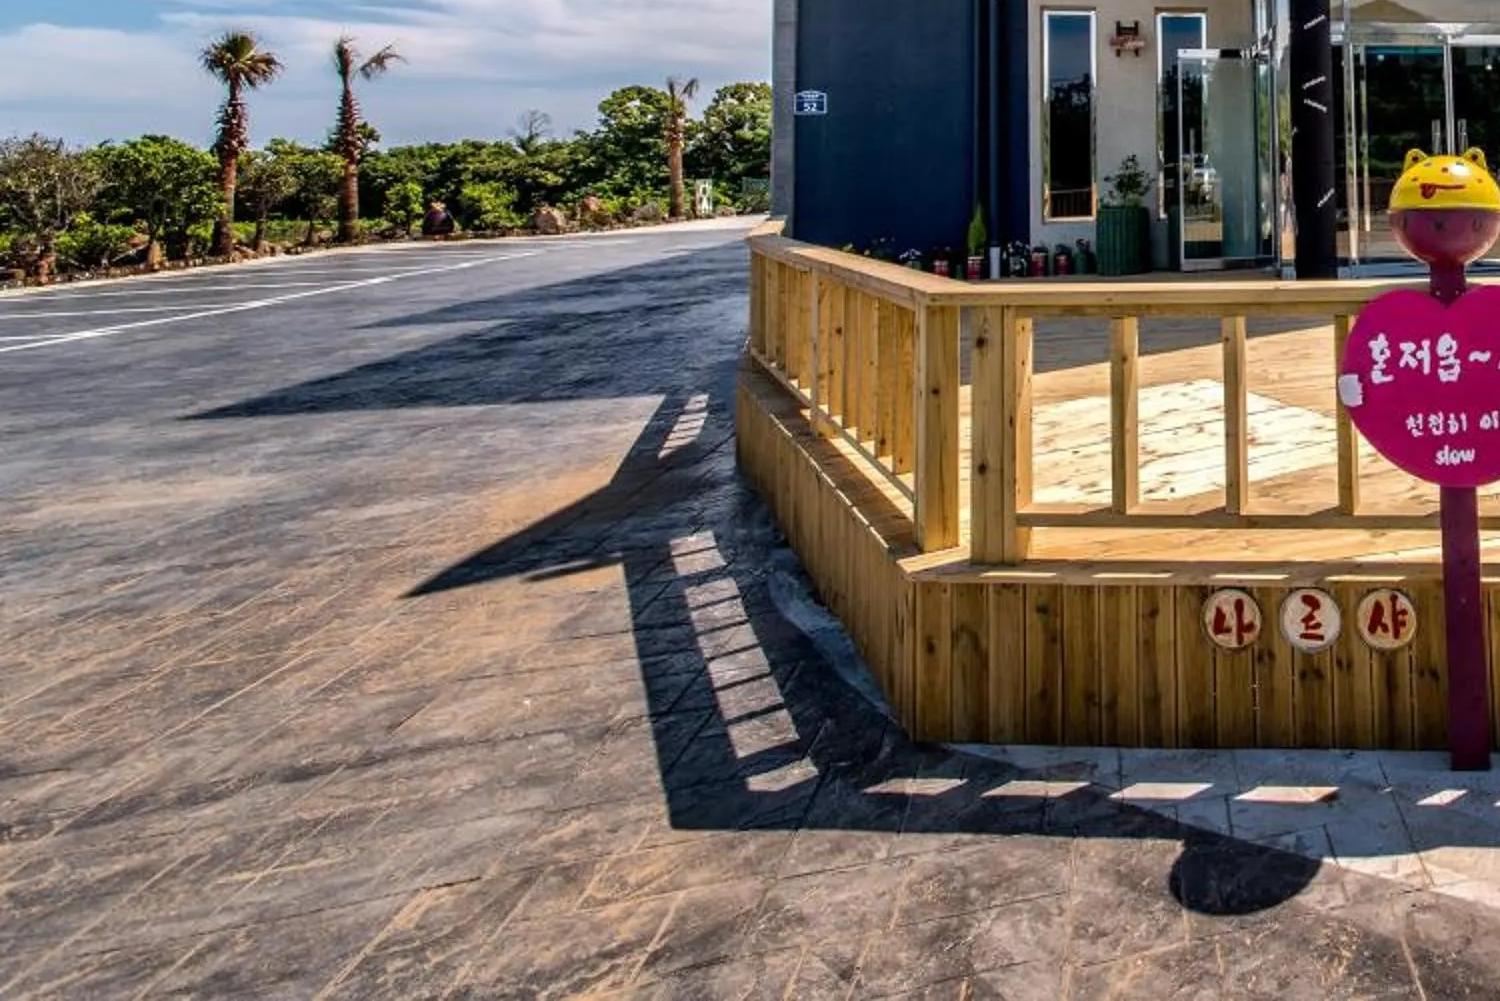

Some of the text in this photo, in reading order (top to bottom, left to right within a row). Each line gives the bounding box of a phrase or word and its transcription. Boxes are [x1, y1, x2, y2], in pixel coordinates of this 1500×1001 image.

[1405, 411, 1467, 437] 천천히
[1435, 445, 1475, 466] slow
[1212, 594, 1408, 647] 나르샤
